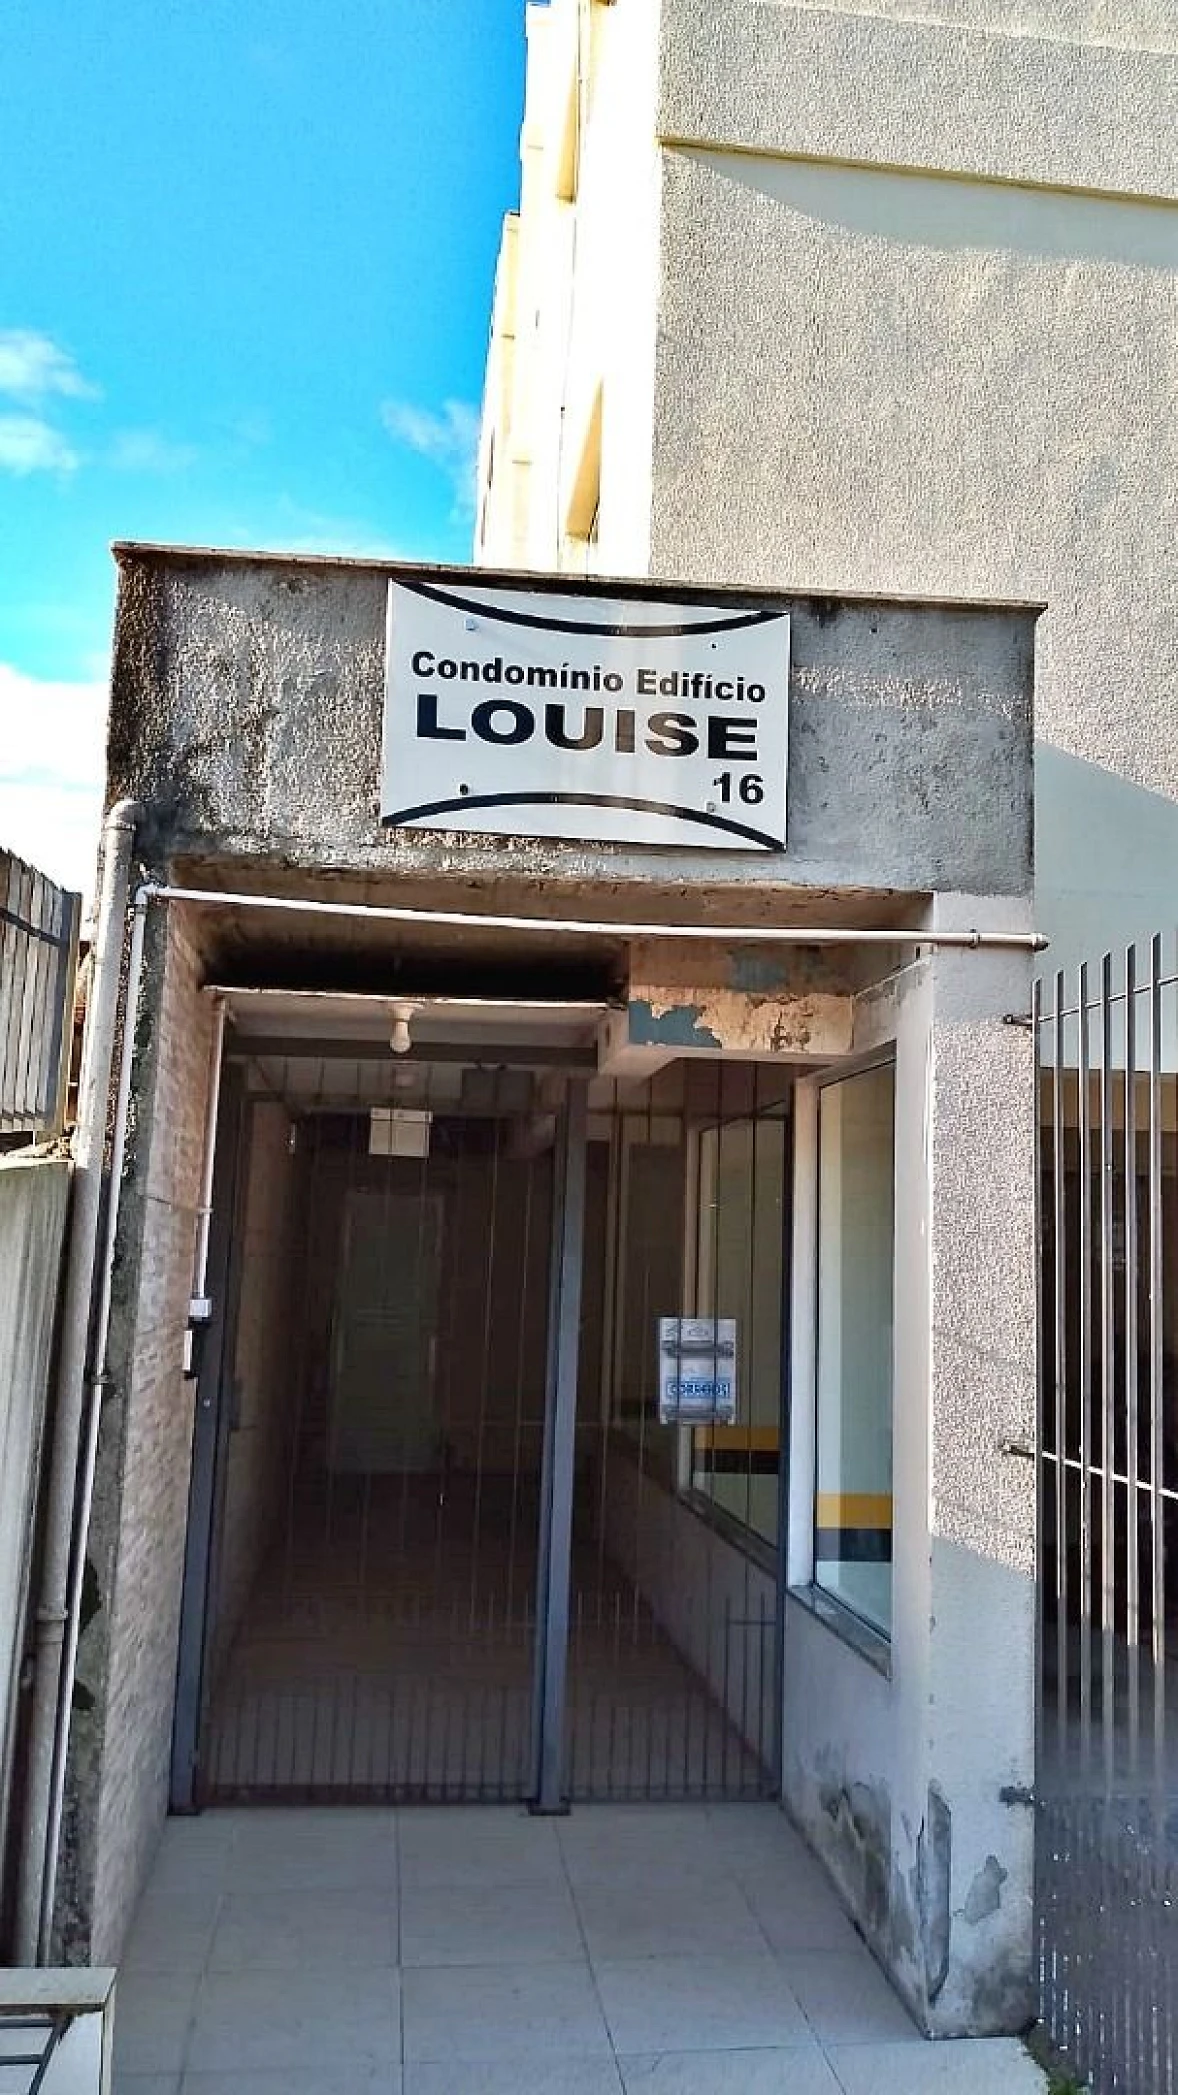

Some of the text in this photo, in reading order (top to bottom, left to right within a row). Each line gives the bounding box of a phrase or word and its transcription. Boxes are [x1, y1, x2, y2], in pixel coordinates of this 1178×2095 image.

[412, 651, 766, 703] Condomínio Edifício
[416, 694, 759, 761] LOUISE
[713, 772, 765, 805] 16
